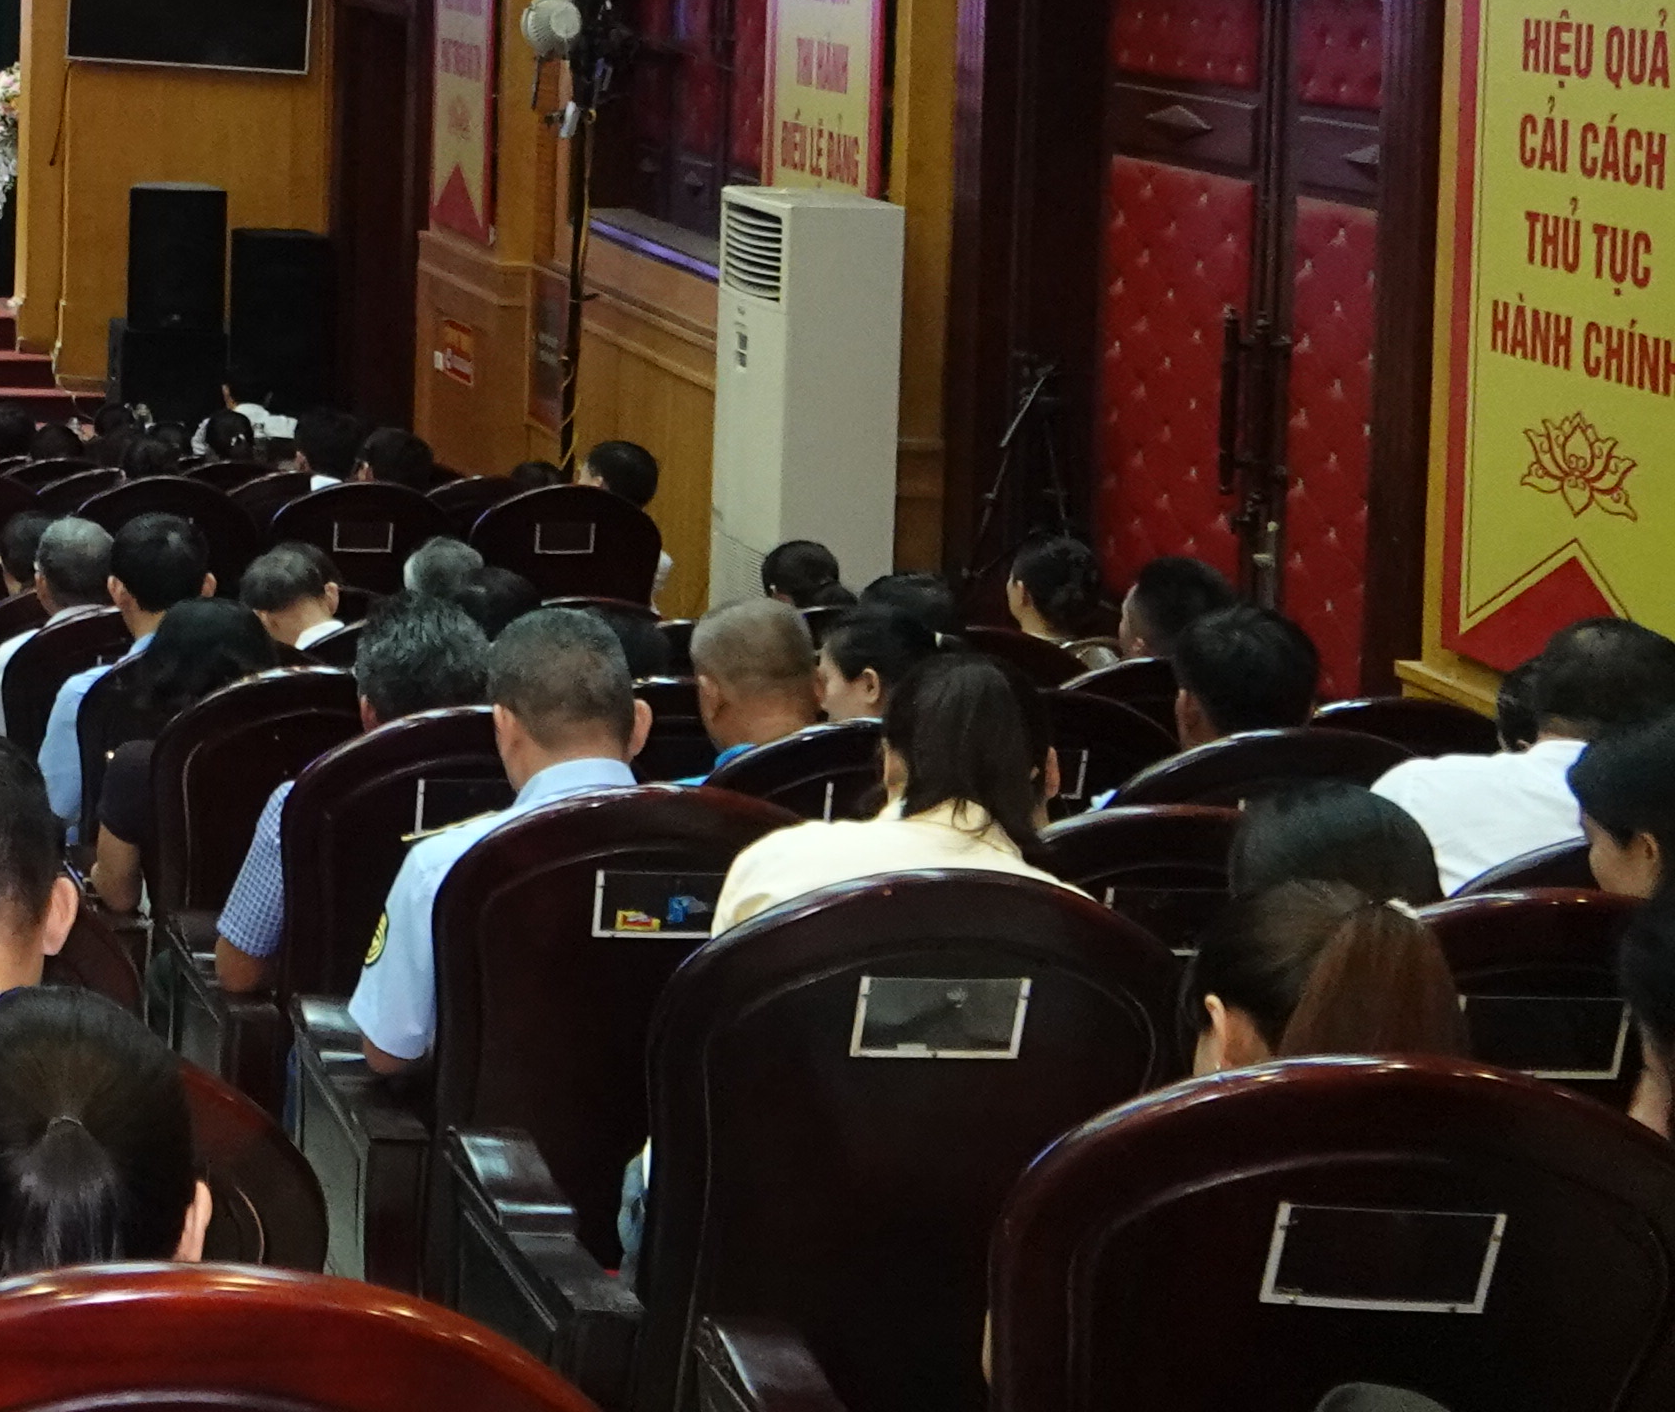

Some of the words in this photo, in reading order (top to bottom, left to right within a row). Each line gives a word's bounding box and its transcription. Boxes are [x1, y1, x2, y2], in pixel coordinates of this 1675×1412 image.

[1522, 9, 1594, 89] HIỆU
[1605, 8, 1670, 89] QUẢ
[1519, 95, 1569, 174] CẢI
[1579, 113, 1667, 190] CÁCH
[1524, 197, 1581, 274] THỦ
[1592, 222, 1653, 296] TỤC
[1490, 291, 1573, 371] HÀNH
